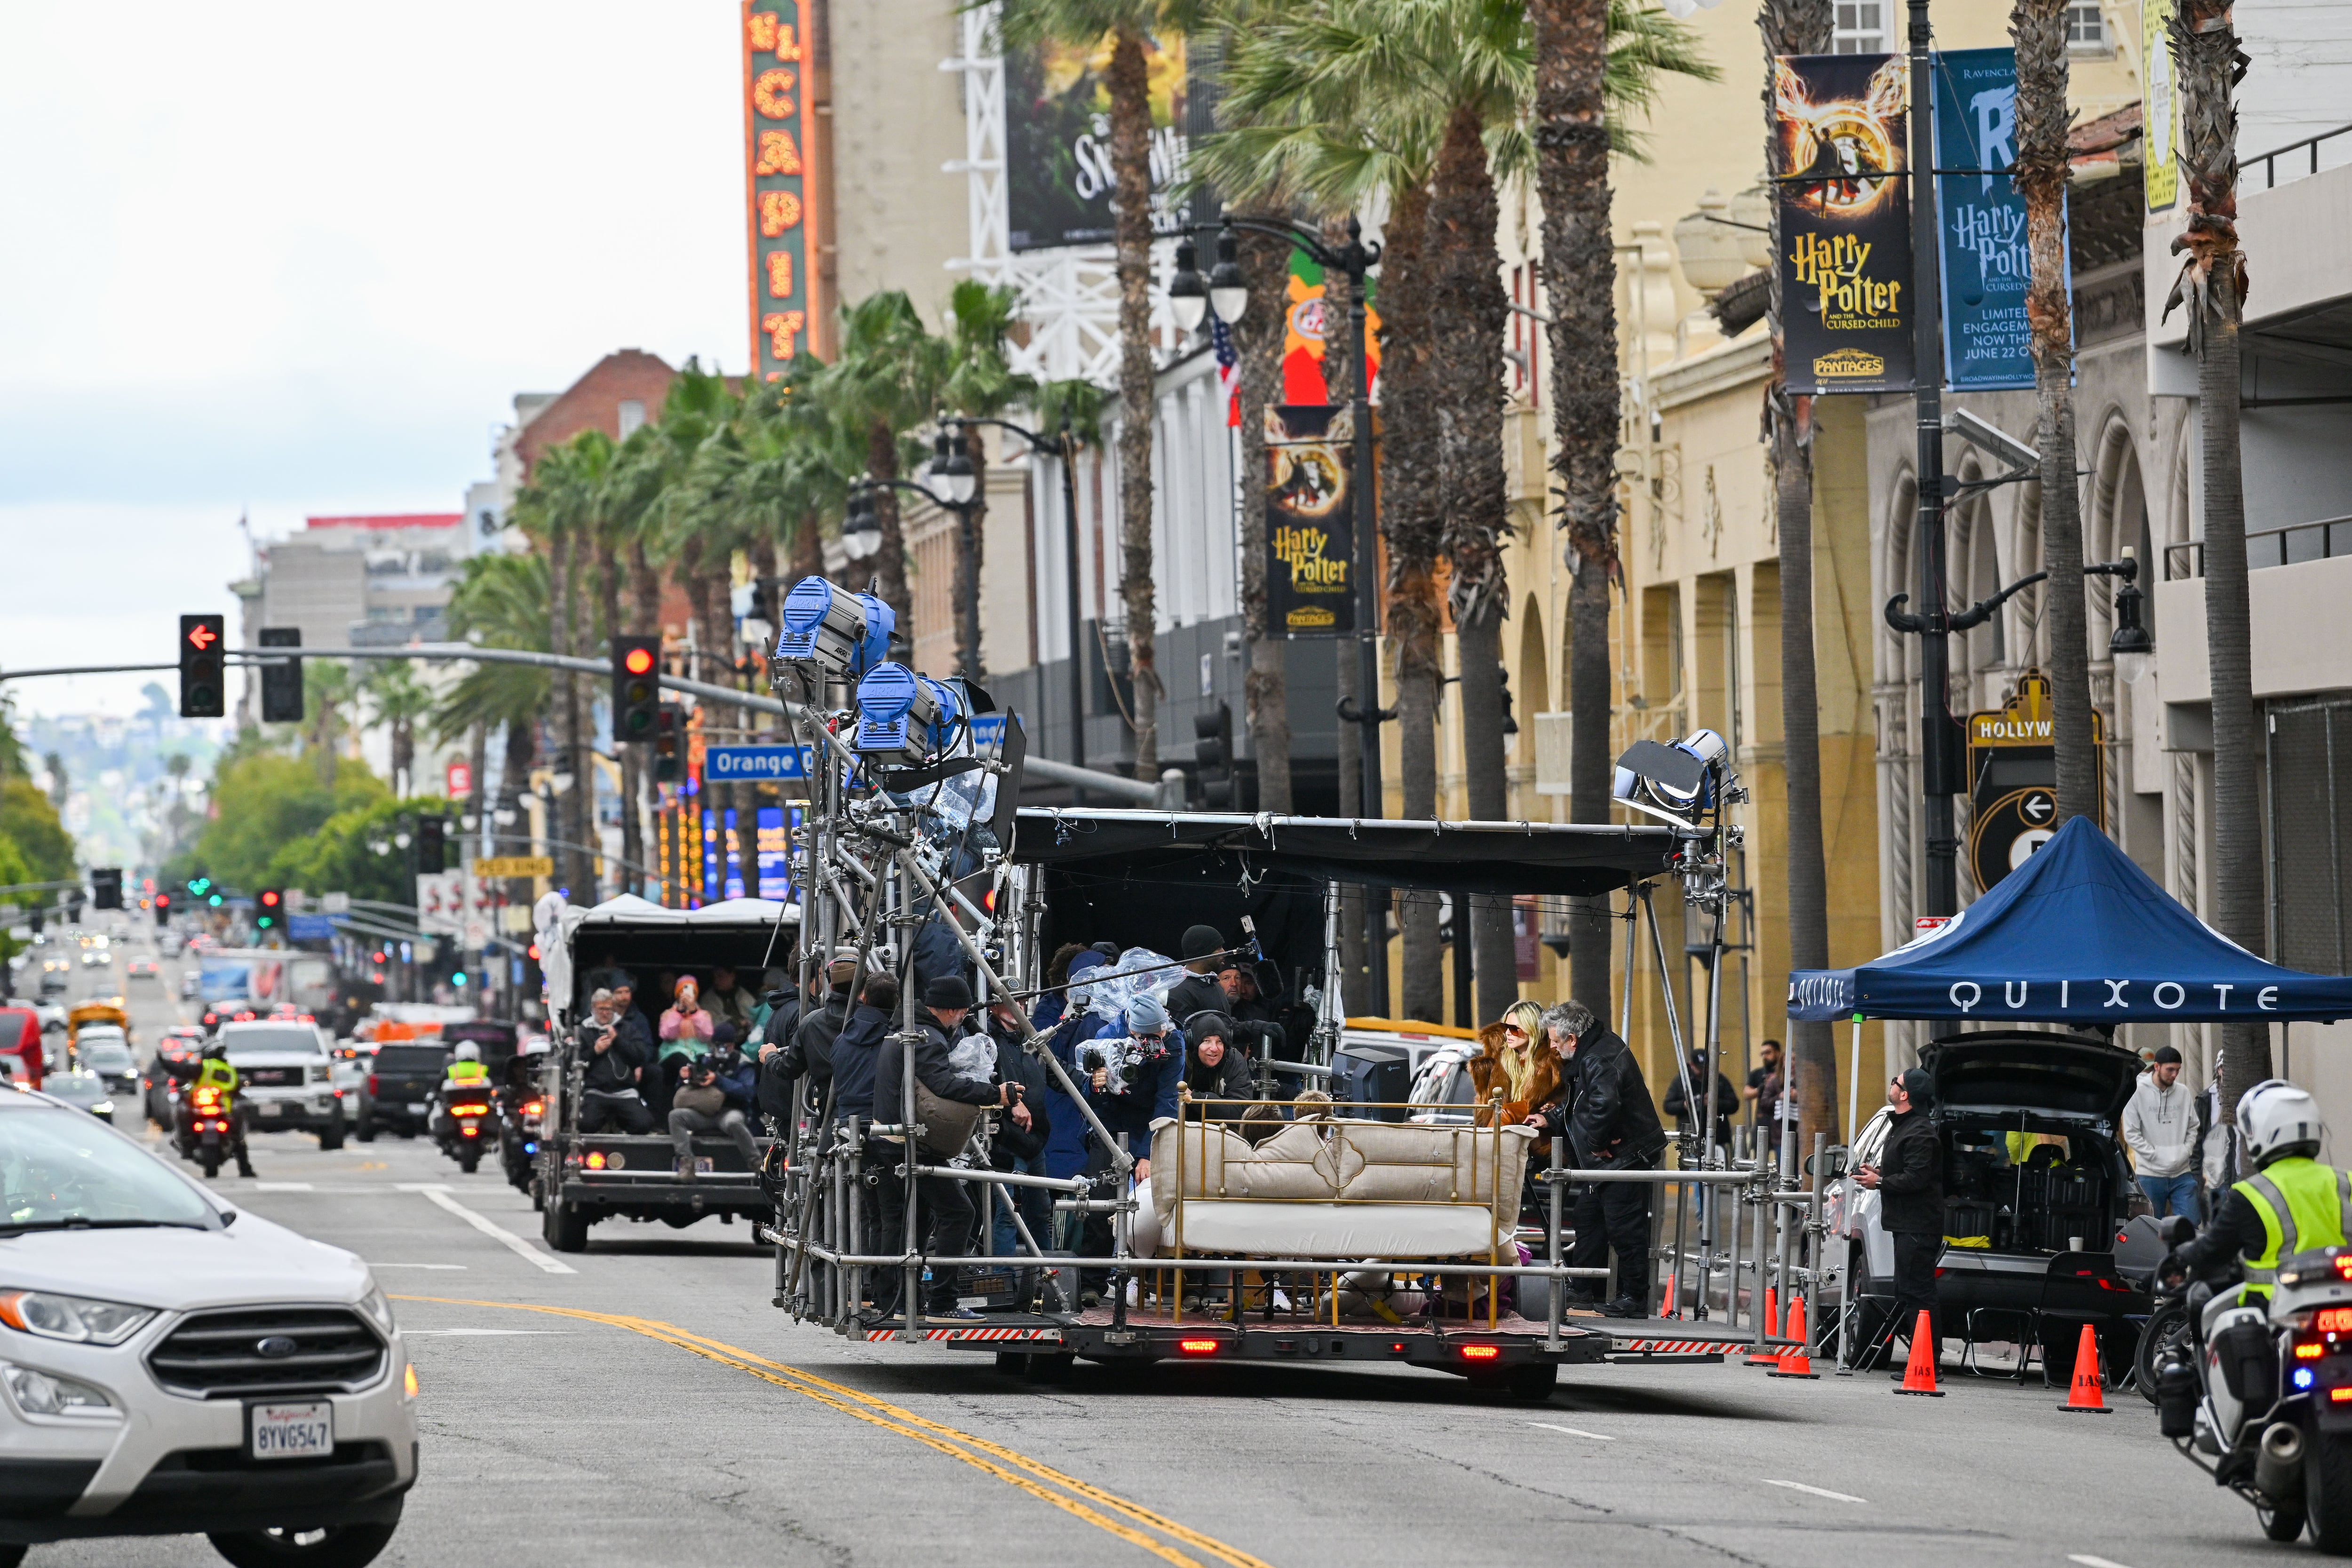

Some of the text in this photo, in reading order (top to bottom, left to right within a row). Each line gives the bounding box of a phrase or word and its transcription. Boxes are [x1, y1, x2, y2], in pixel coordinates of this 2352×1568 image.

[1963, 69, 2016, 79] RAVENCLA
[754, 67, 805, 383] CAPIT
[1951, 203, 2025, 251] Harry
[1789, 232, 1872, 284] Harry
[1986, 283, 2022, 292] CURSED
[1817, 269, 1901, 328] Potter
[1827, 318, 1901, 329] CURSED CHILD
[1963, 320, 2031, 334] ENGAGEM
[1973, 334, 2005, 346] NOW
[1965, 348, 1998, 359] JUNE
[2002, 347, 2015, 358] 22
[1815, 359, 1882, 372] PANTAGES
[1271, 525, 1328, 562] Harry
[1291, 550, 1347, 587] Potter
[834, 646, 848, 658] ARRI
[1981, 721, 2051, 738] HOLLYW
[917, 733, 926, 745] ARRI
[717, 753, 794, 776] Orange
[1798, 977, 1844, 1011] QUIXOTE
[1949, 979, 2278, 1012] QUIXOTE
